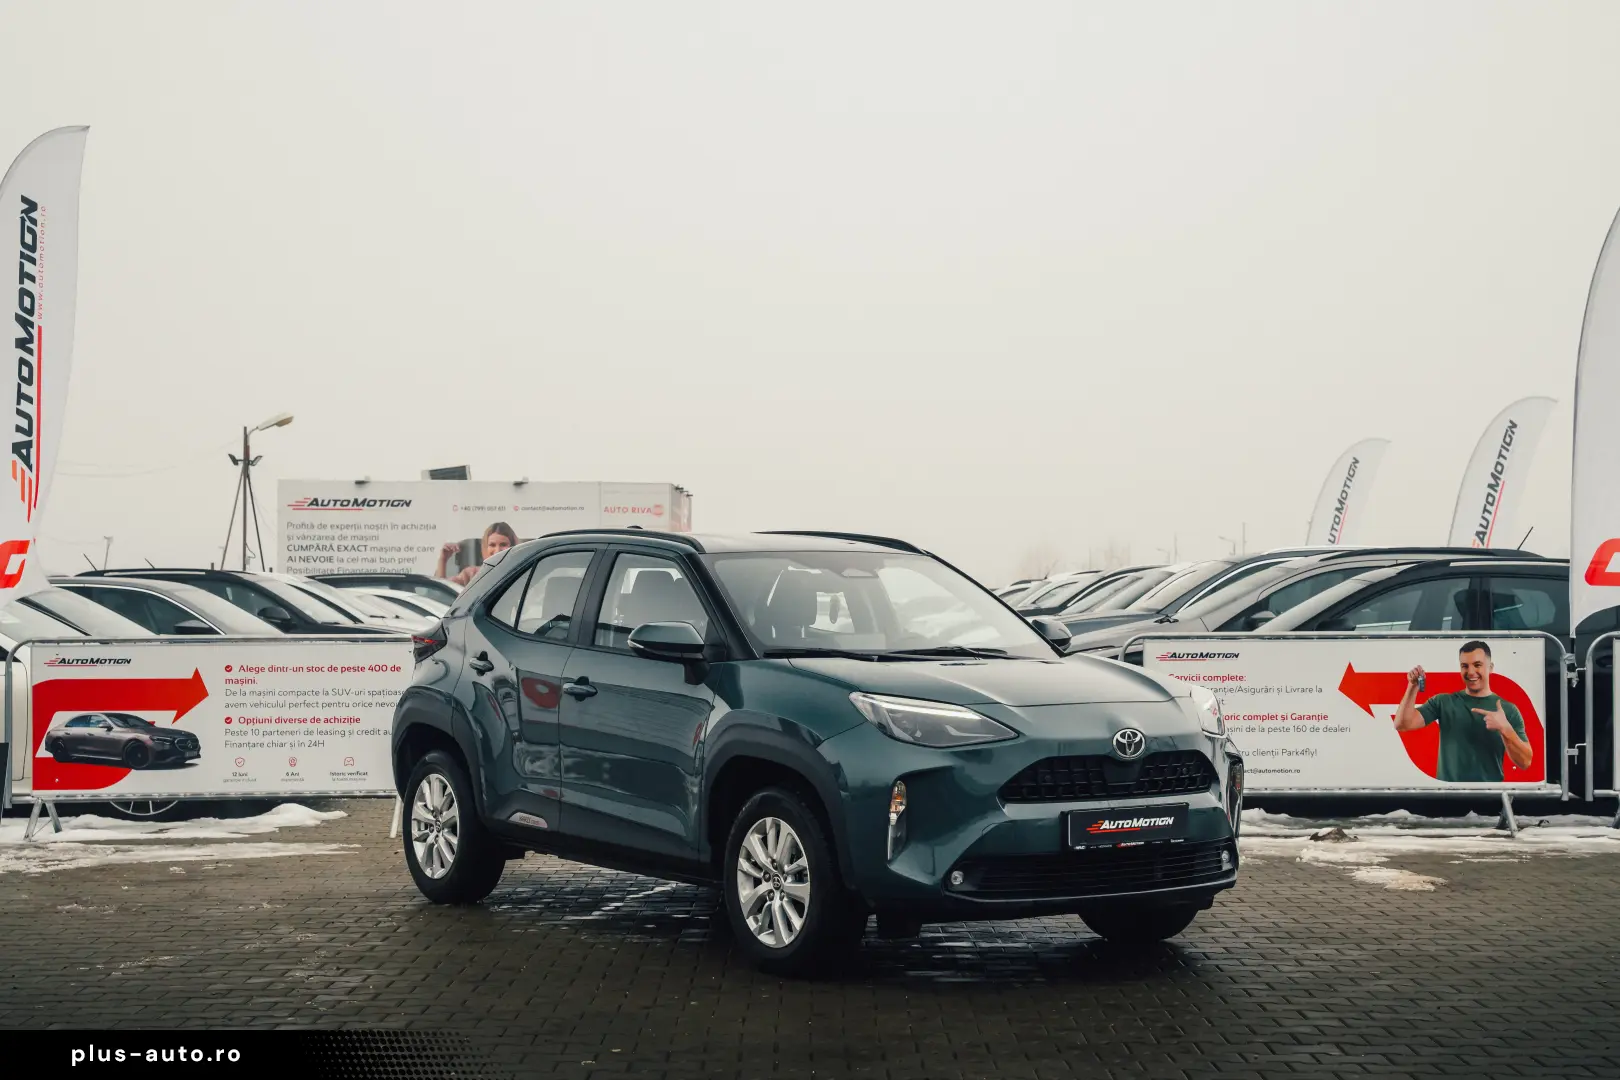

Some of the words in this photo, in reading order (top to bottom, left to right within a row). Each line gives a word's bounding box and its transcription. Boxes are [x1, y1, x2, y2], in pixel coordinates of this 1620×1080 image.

[38, 206, 47, 320] www.automotion.ro
[1327, 457, 1360, 545] UTOMOTION
[604, 506, 629, 514] AUTO
[631, 506, 652, 514] RIVA
[317, 522, 328, 530] de
[337, 533, 349, 541] de
[287, 543, 335, 553] CUMPĂRĂ
[337, 544, 368, 552] EXACT
[404, 544, 415, 552] de
[287, 555, 300, 563] AI
[302, 555, 334, 563] NEVOIE
[337, 555, 345, 563] la
[346, 555, 359, 563] cel
[361, 555, 377, 563] mai
[380, 555, 396, 563] bun
[238, 664, 266, 675] Alege
[268, 664, 304, 673] dintr-un
[306, 665, 326, 673] stoc
[327, 664, 339, 673] de
[340, 665, 366, 674] peste
[368, 664, 388, 672] 400
[390, 664, 402, 672] de
[225, 677, 258, 686] mașini.
[1202, 673, 1247, 684] complete:
[225, 688, 238, 697] De
[239, 688, 247, 697] la
[249, 688, 276, 699] mașini
[278, 689, 320, 698] compacte
[322, 688, 330, 697] la
[331, 688, 366, 697] SUV-uri
[1200, 685, 1275, 696] ranție/Asigurări
[1285, 685, 1314, 694] Livrare
[1315, 685, 1323, 694] la
[249, 700, 286, 709] vehiculul
[288, 700, 319, 710] perfect
[321, 701, 350, 710] pentru
[352, 700, 373, 708] orice
[238, 716, 273, 726] Opțiuni
[274, 716, 307, 725] diverse
[310, 716, 321, 724] de
[323, 716, 361, 726] achiziție
[1242, 712, 1279, 722] complet
[1280, 713, 1288, 722] și
[1290, 712, 1329, 723] Garanție
[225, 728, 249, 737] Peste
[251, 728, 260, 736] 10
[262, 729, 301, 738] parteneri
[303, 728, 314, 736] de
[316, 728, 346, 738] leasing
[356, 727, 381, 736] credit
[1245, 725, 1256, 733] de
[1258, 725, 1266, 733] la
[1268, 726, 1291, 736] peste
[1293, 725, 1308, 733] 160
[1309, 725, 1321, 733] de
[1322, 725, 1351, 733] dealeri
[225, 740, 265, 750] Finanțare
[267, 739, 286, 748] chiar
[289, 740, 296, 750] și
[307, 739, 325, 748] 24H
[1251, 747, 1279, 758] clienții
[1281, 747, 1318, 758] Park4fly!
